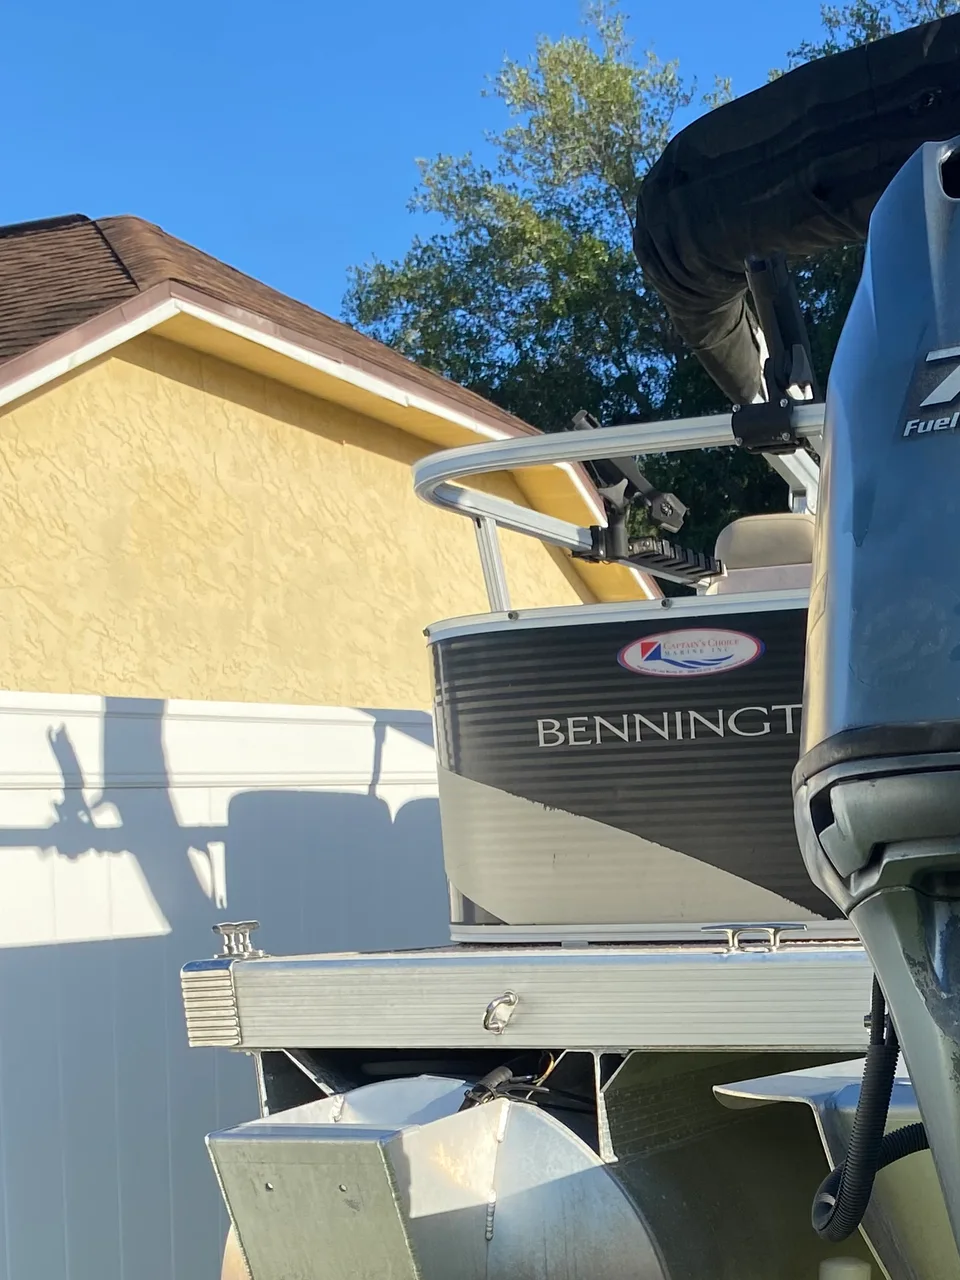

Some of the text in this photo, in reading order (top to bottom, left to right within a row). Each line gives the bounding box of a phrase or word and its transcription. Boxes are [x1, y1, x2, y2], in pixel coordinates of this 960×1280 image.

[903, 411, 960, 437] Fuel
[663, 638, 740, 650] CAPTAIN'S CHOICE
[664, 648, 704, 656] MARINE
[536, 703, 803, 749] BENNINGT
